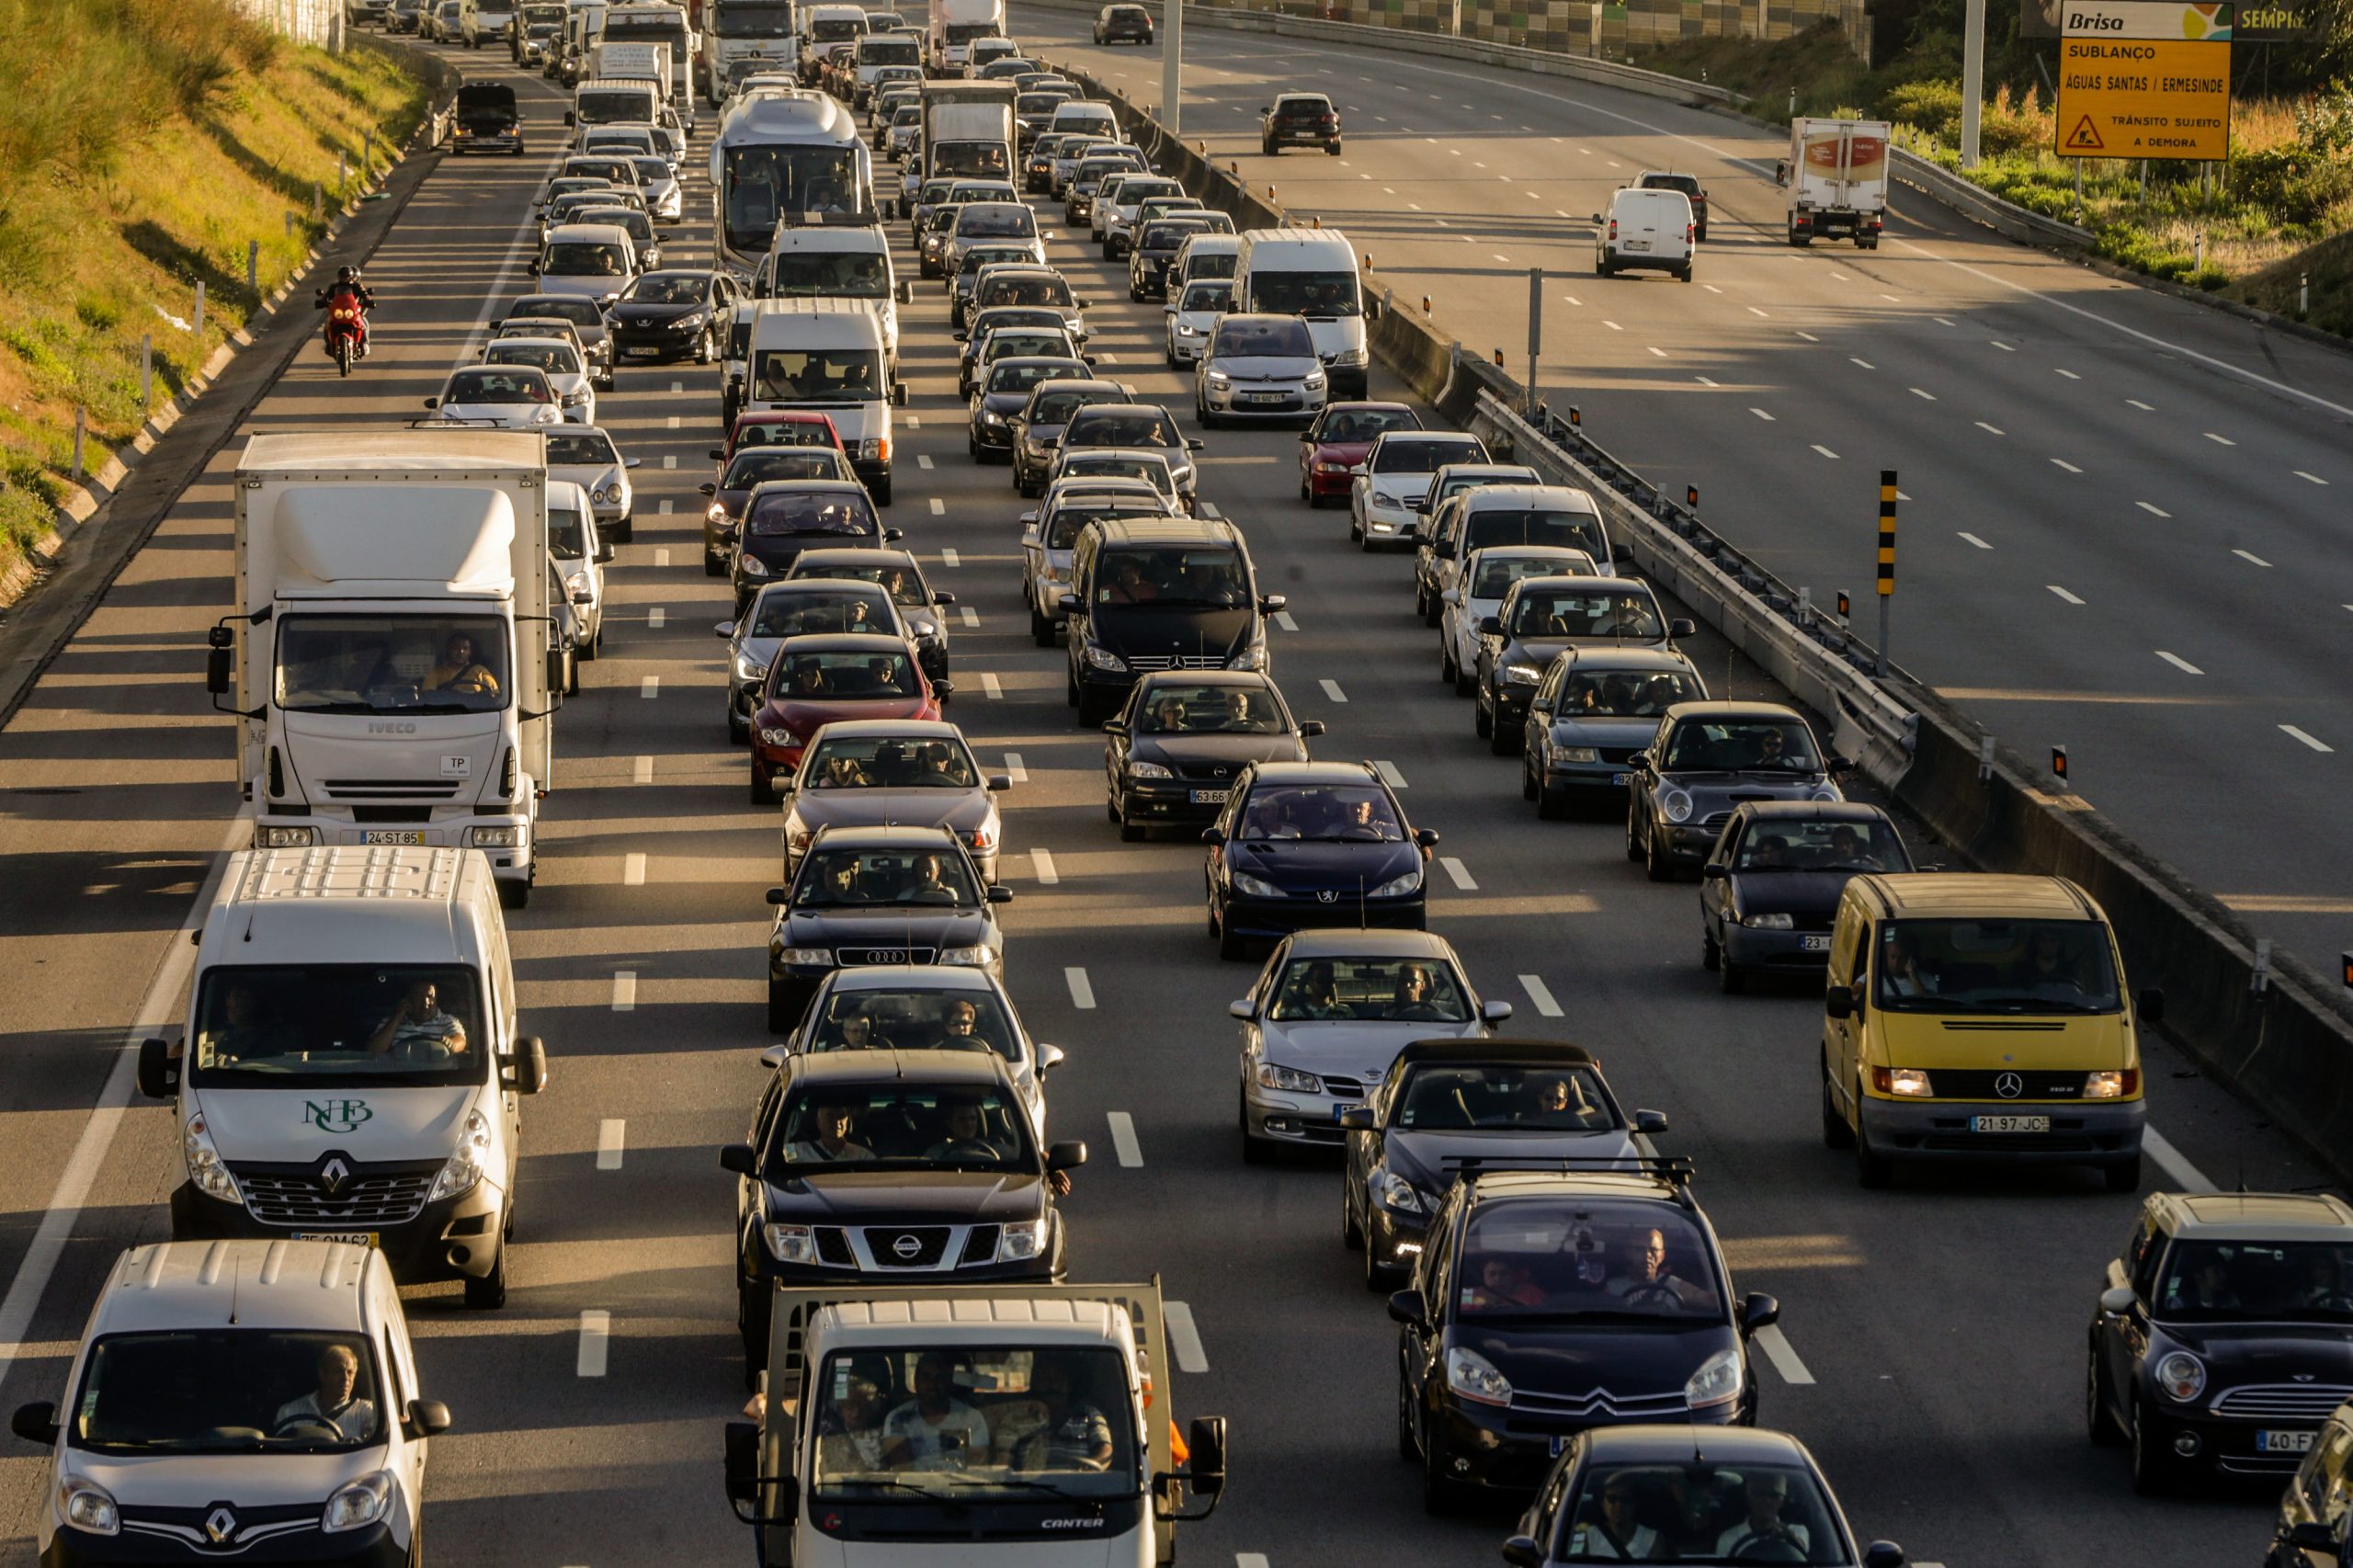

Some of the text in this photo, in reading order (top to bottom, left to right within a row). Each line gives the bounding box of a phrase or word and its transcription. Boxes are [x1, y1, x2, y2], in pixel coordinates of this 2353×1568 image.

[2068, 13, 2124, 30] Brisa
[2068, 45, 2155, 62] SUBLANÇO
[2065, 73, 2101, 90] ÁGUAS
[2107, 77, 2148, 91] SANTAS
[2162, 77, 2223, 93] ERMESINDE
[2175, 118, 2221, 128] SUJEITO
[2148, 138, 2197, 147] DEMORA
[369, 722, 416, 733] IVECO
[450, 757, 465, 768] TP
[1041, 1517, 1104, 1528] CANTER
